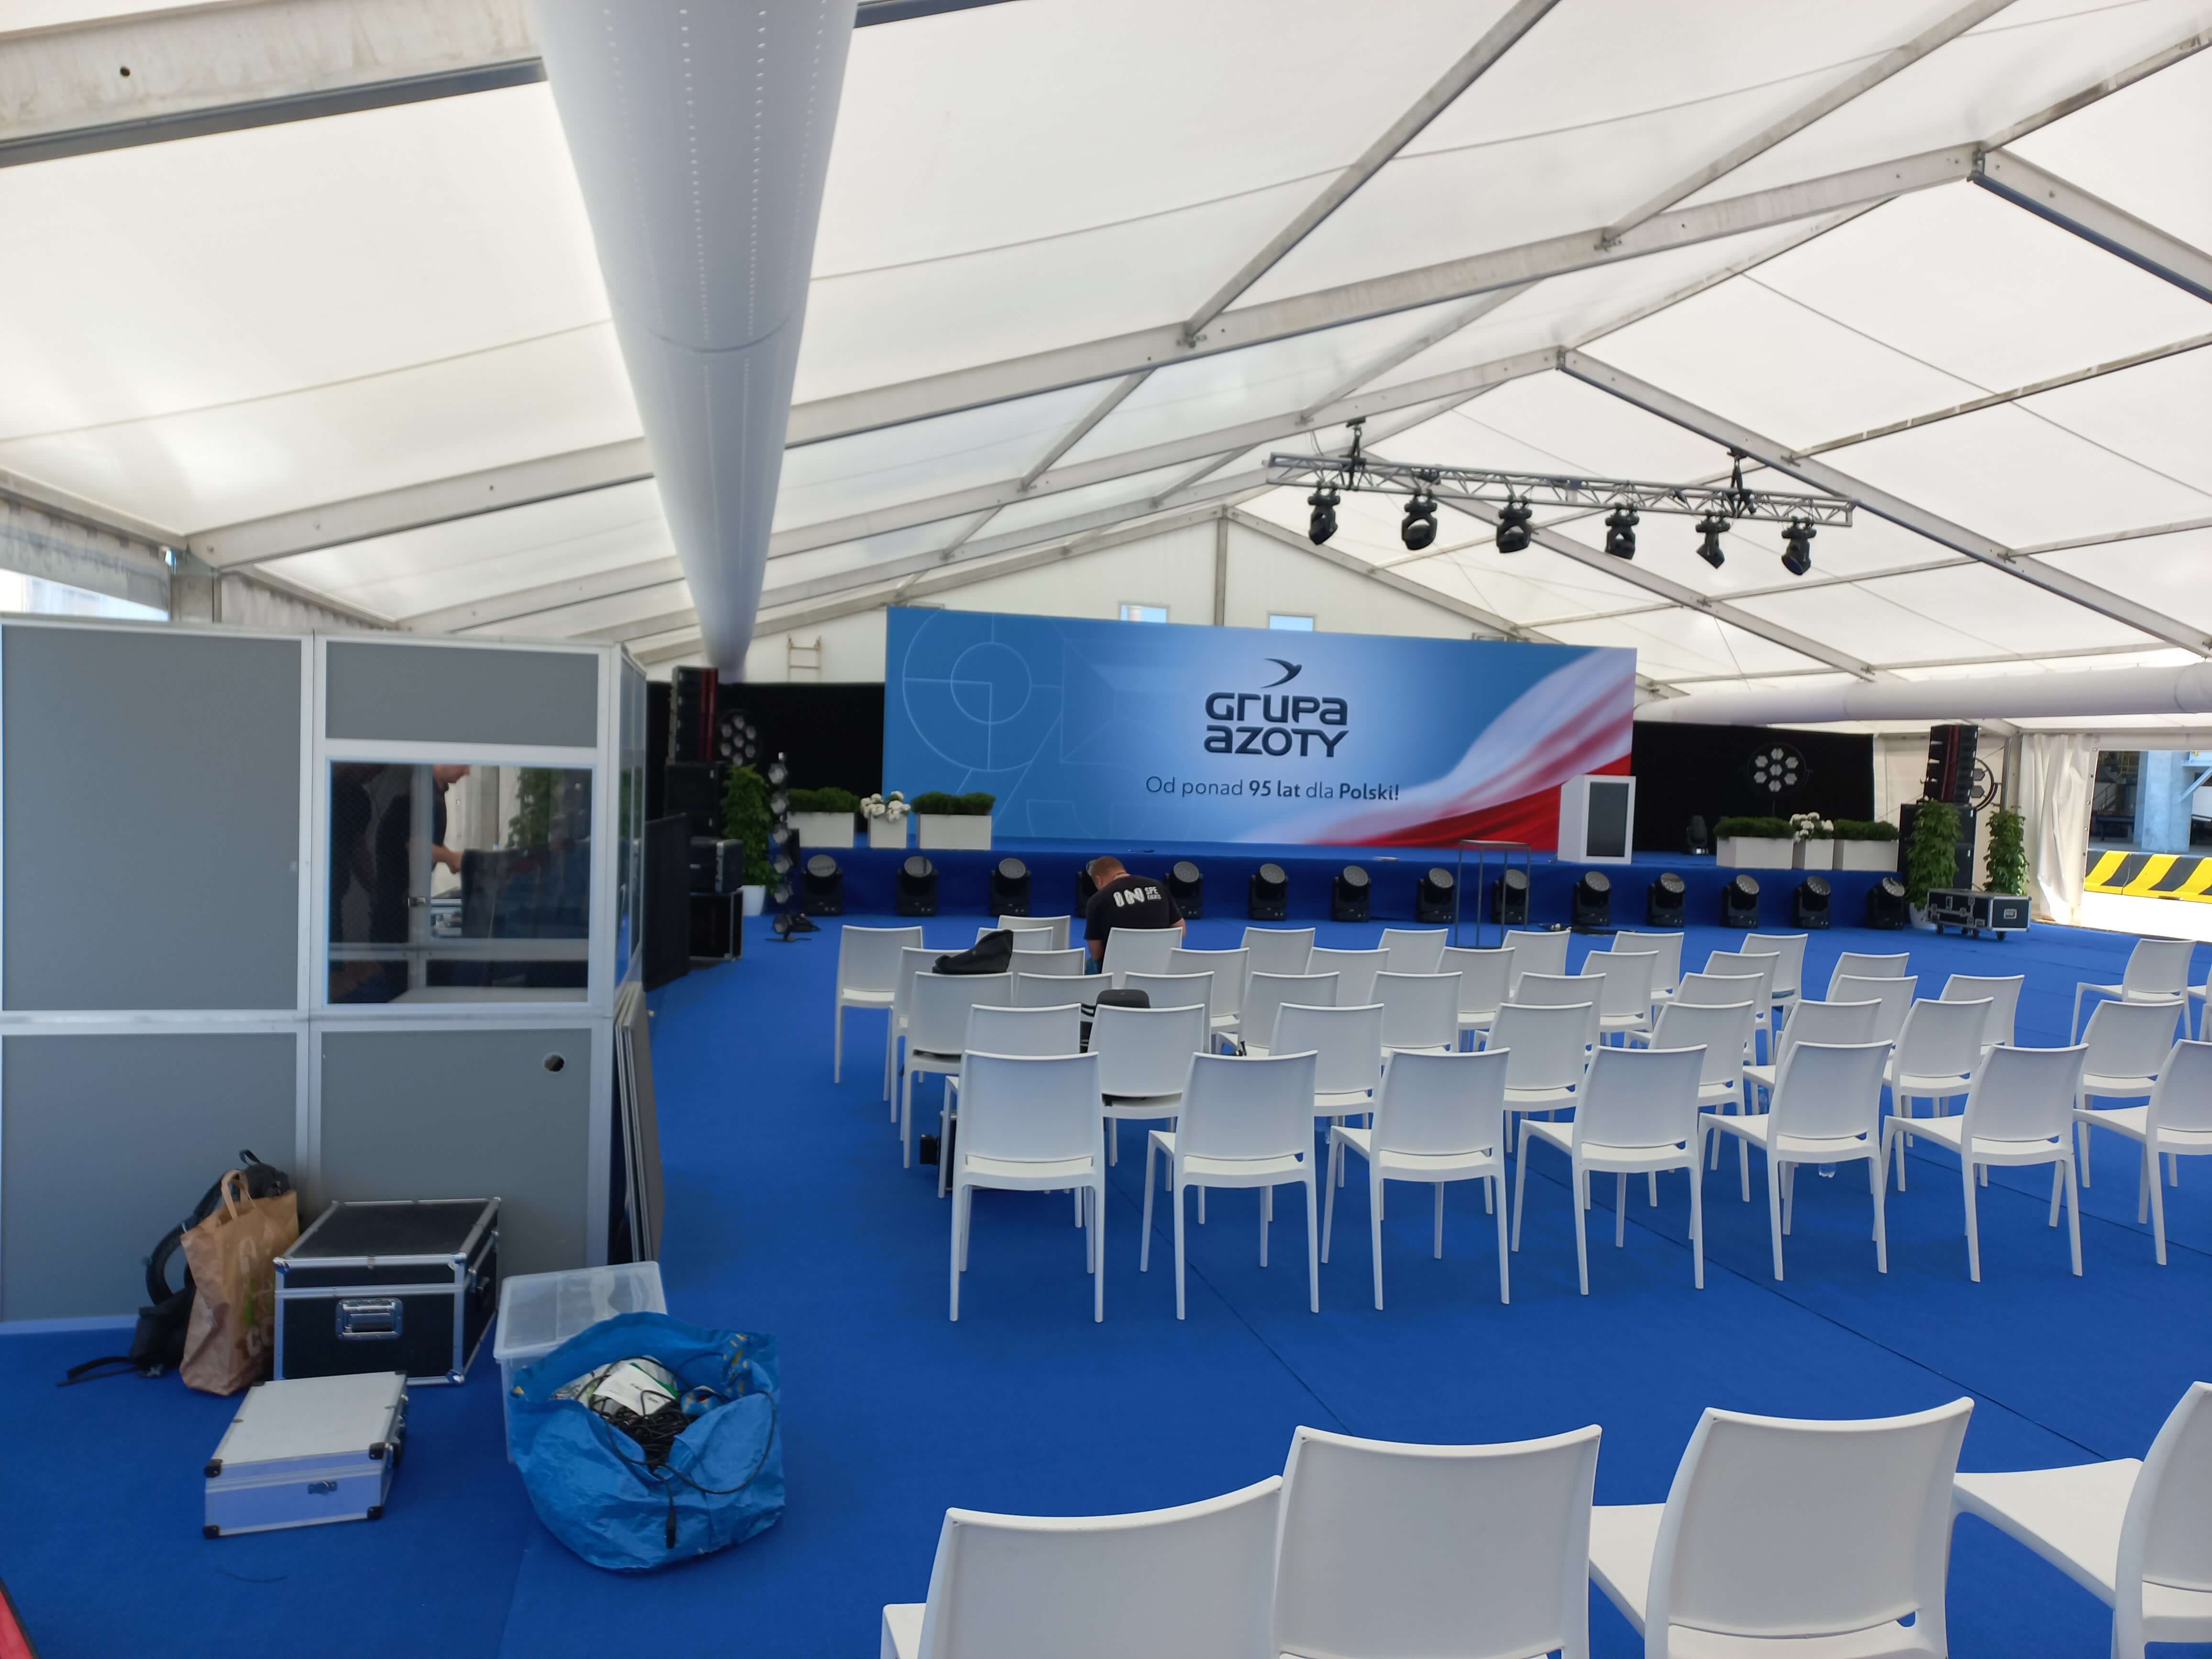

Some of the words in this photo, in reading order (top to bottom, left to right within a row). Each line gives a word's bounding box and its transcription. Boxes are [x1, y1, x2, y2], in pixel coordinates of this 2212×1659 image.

[1146, 776, 1175, 793] Od
[1182, 779, 1243, 798] ponad
[1249, 780, 1271, 796] 95
[1277, 780, 1301, 797] lat
[1306, 781, 1333, 798] dla
[1339, 783, 1399, 800] Polski!
[1113, 887, 1145, 907] IN
[1144, 886, 1158, 895] SPE
